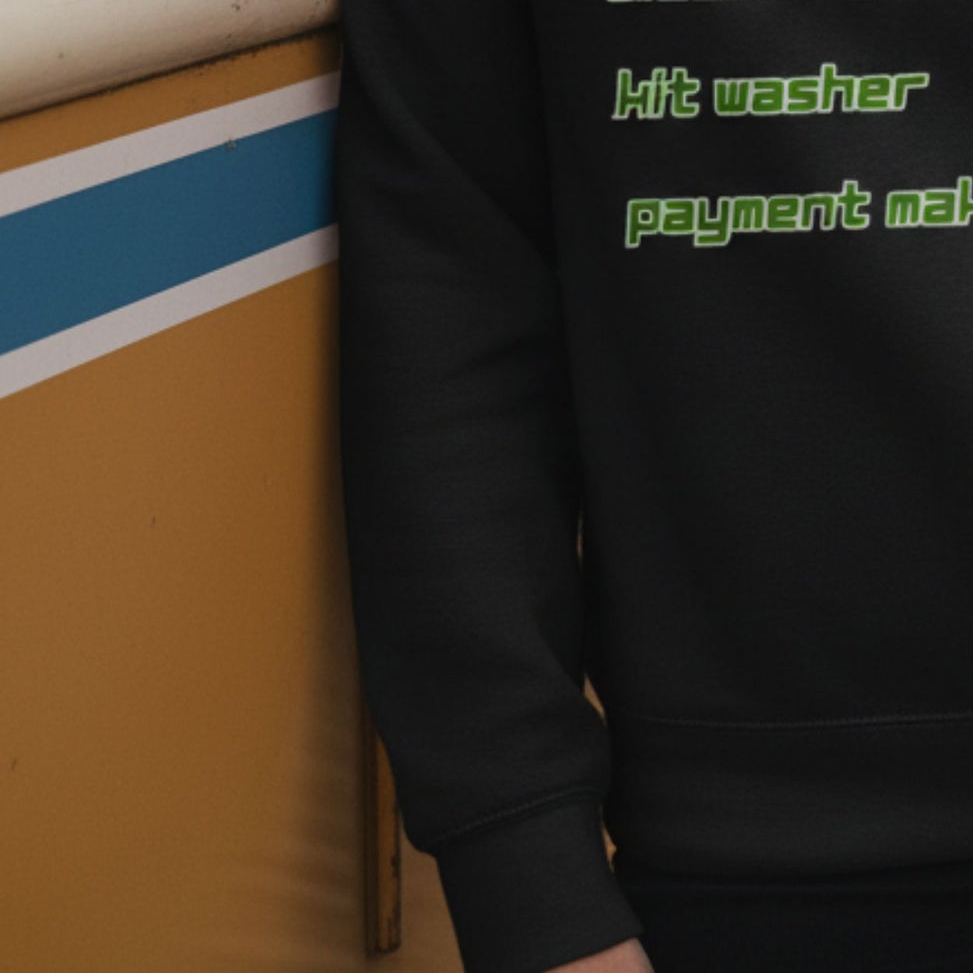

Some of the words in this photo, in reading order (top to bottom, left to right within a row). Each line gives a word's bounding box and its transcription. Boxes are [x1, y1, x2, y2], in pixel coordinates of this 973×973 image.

[612, 67, 701, 120] kit
[713, 62, 930, 116] washer
[625, 179, 872, 248] payment
